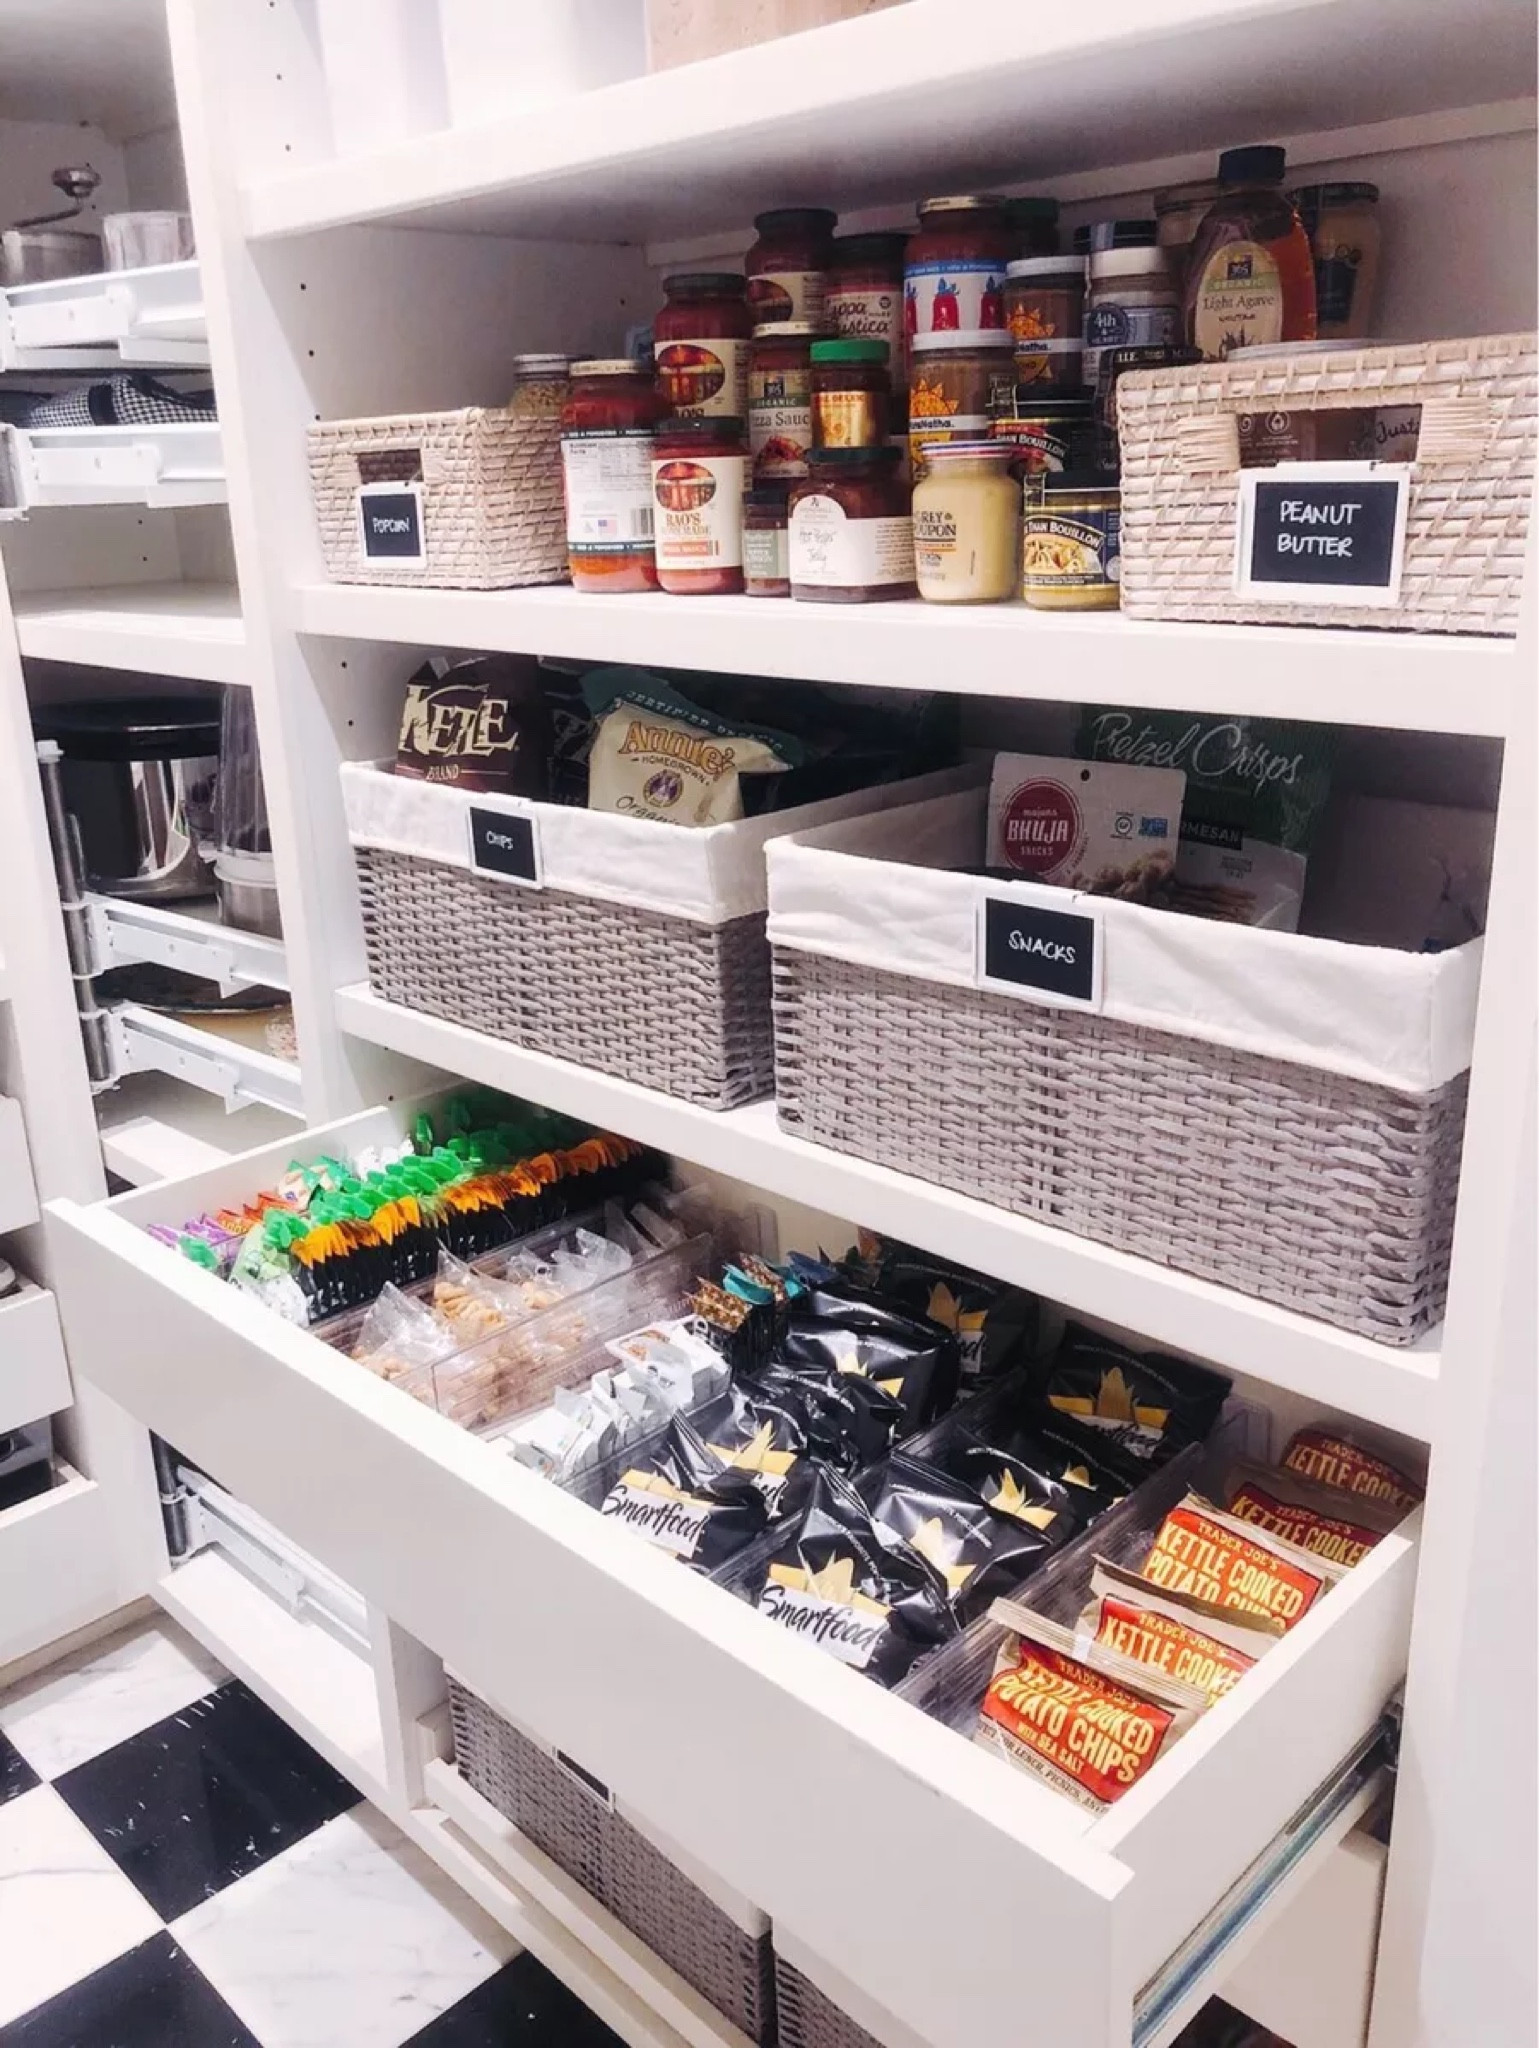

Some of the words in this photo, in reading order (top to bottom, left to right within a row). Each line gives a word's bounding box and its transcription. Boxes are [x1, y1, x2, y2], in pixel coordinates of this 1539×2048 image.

[1203, 296, 1233, 311] Light
[1235, 295, 1275, 311] Agave
[775, 411, 809, 427] Sauc
[372, 516, 411, 534] POPCORN
[1279, 500, 1363, 525] PEANUT
[1050, 522, 1102, 549] BOUILLON
[1276, 532, 1353, 558] BUTTER
[426, 762, 461, 781] BRAND
[642, 754, 706, 786] HOMEGROWN
[1091, 712, 1201, 767] Pretzel
[1191, 723, 1304, 798] Crisps
[485, 829, 514, 851] CHIPS
[1006, 819, 1068, 844] BHUJA
[1008, 929, 1076, 964] SNACKS
[1285, 1444, 1351, 1486] KETTLE
[1351, 1471, 1420, 1510] COOKE
[601, 1484, 709, 1542] Smartfood
[1230, 1495, 1304, 1546] KETTLE
[1198, 1522, 1243, 1553] TRADER
[1245, 1547, 1281, 1572] JOE'S
[1143, 1549, 1222, 1601] POTATO
[1157, 1520, 1231, 1580] KETTLE
[1227, 1558, 1304, 1618] COOKED
[761, 1584, 889, 1652] Smartfood
[1139, 1613, 1187, 1643] TRADER
[1100, 1615, 1177, 1672] KETTLE
[1174, 1647, 1242, 1694] COOKE
[1059, 1660, 1106, 1692] TRADER
[1106, 1688, 1138, 1709] JOE'S
[989, 1674, 1069, 1738] POTATO
[1067, 1717, 1140, 1783] CHIPS
[1077, 1698, 1155, 1755] COOKED
[1037, 1734, 1058, 1757] SEA
[1058, 1747, 1085, 1775] SALT
